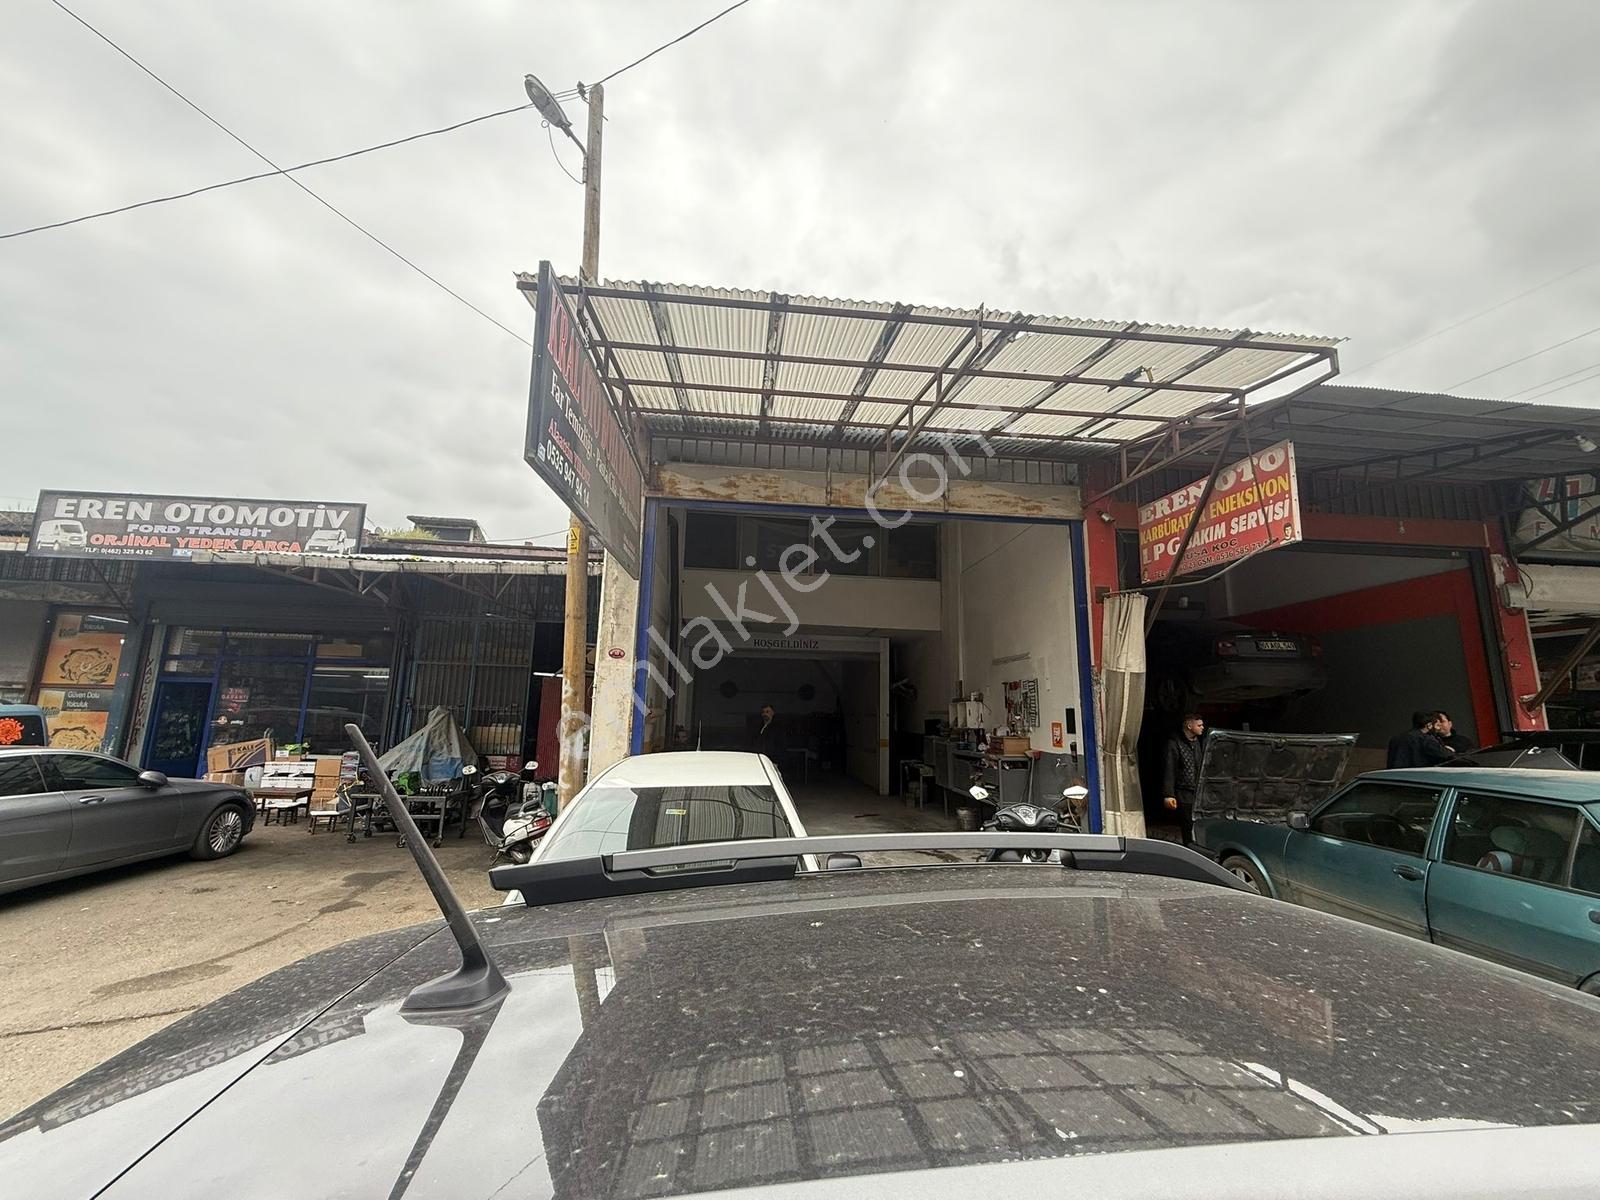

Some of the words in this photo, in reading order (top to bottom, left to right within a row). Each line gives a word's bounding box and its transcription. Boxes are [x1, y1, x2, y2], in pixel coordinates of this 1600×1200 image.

[551, 369, 564, 410] Far
[546, 439, 564, 475] 0535
[563, 462, 576, 489] 947
[1214, 447, 1286, 491] OTO
[54, 498, 153, 521] EREN
[164, 502, 350, 528] OTOMOTİV
[1210, 472, 1290, 519] ENJEKSİYON
[1230, 494, 1290, 535] SERVİSİ
[90, 533, 171, 547] ORJİNAL
[176, 536, 238, 550] YEDEK
[127, 523, 181, 534] FORD
[186, 526, 272, 537] TRANSİT
[1183, 548, 1208, 561] USA
